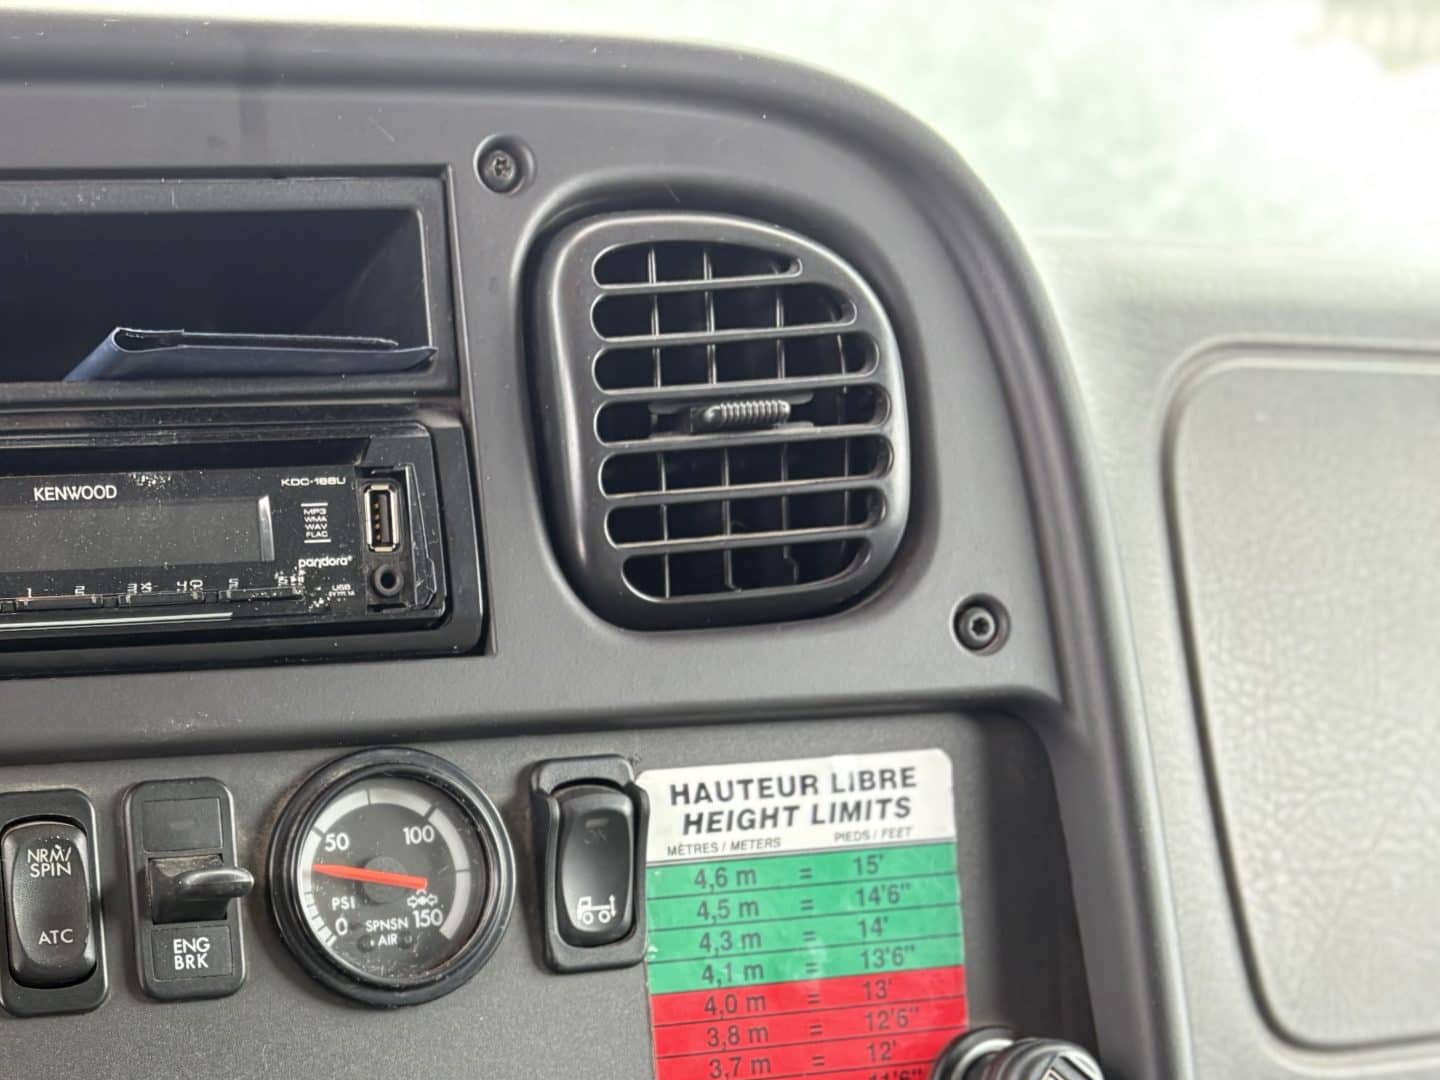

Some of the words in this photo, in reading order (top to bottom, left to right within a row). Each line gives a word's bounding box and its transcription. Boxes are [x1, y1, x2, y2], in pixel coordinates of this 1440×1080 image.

[33, 484, 118, 501] KENWOOD
[298, 555, 349, 569] pandora
[670, 774, 819, 806] HAUTEUR
[830, 766, 917, 794] LIBRE
[682, 805, 800, 835] HEIGHT
[810, 796, 912, 825] LIMITS
[325, 833, 350, 851] 50
[403, 825, 435, 845] 100
[833, 830, 871, 843] PIEDS
[880, 826, 913, 839] FEET
[729, 836, 782, 852] METERS
[30, 863, 72, 878] SPIN
[694, 866, 728, 892] 4,6
[736, 870, 757, 886] m
[853, 853, 885, 876] 15'
[331, 896, 356, 911] PSI
[697, 898, 731, 923] 4,5
[738, 901, 759, 918] m
[855, 882, 911, 907] 14'6"
[335, 918, 348, 935] 0
[365, 918, 409, 933] SPNSN
[412, 910, 443, 928] 150
[38, 928, 74, 945] ATC
[377, 934, 398, 947] AIR
[699, 930, 733, 955] 4,3
[741, 932, 762, 949] m
[857, 916, 888, 938] 14'
[173, 937, 211, 954] ENG
[174, 953, 209, 970] BRK
[702, 961, 733, 986] 4,1
[743, 963, 764, 980] m
[860, 945, 915, 970] 13'6"
[703, 993, 738, 1020] 4,0
[746, 996, 766, 1012] m
[863, 978, 892, 1000] 13'
[706, 1025, 741, 1051] 3,8
[749, 1027, 769, 1044] m
[864, 1006, 920, 1031] 12'6"
[751, 1058, 771, 1076] m
[866, 1040, 897, 1062] 12'
